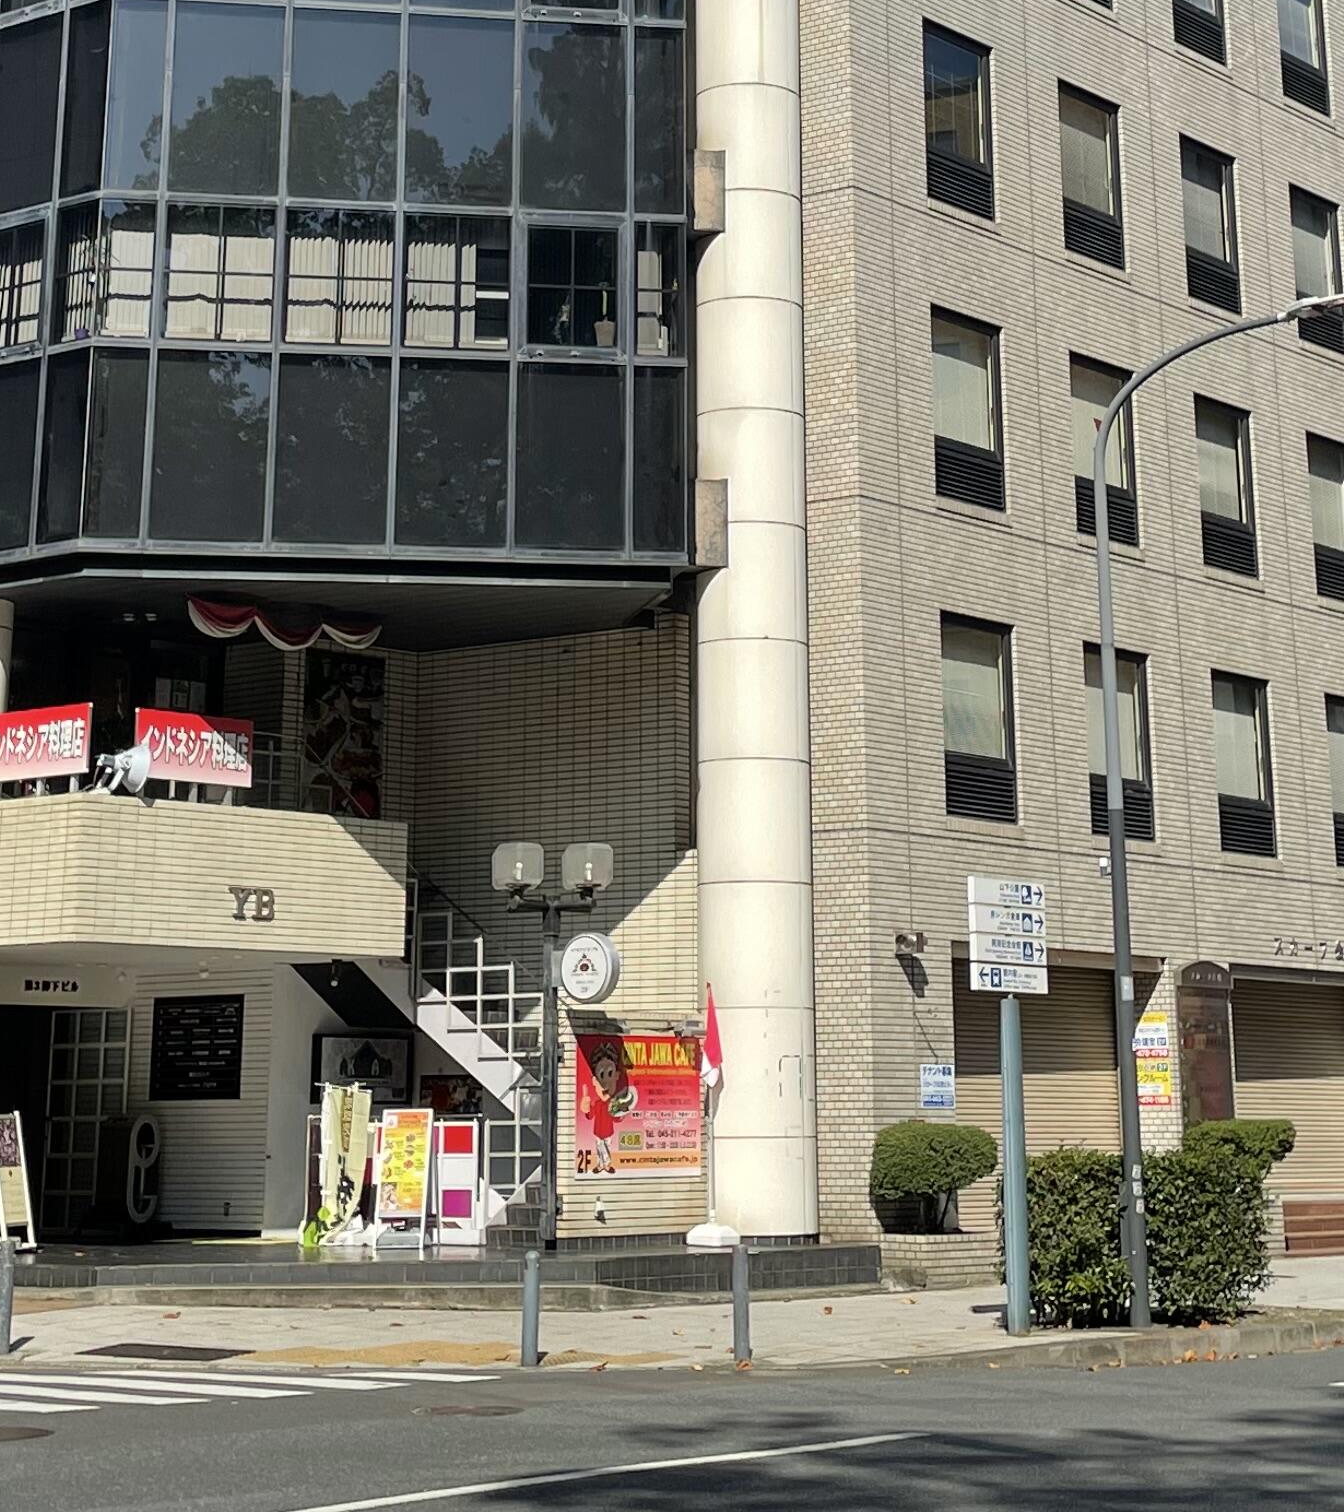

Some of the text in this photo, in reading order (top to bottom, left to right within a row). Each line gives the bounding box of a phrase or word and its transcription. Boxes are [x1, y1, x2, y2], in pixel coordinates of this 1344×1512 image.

[141, 724, 249, 772] インドネシア料理店
[228, 887, 275, 922] YB
[649, 1042, 673, 1066] JAWA
[577, 1149, 592, 1174] 2F
